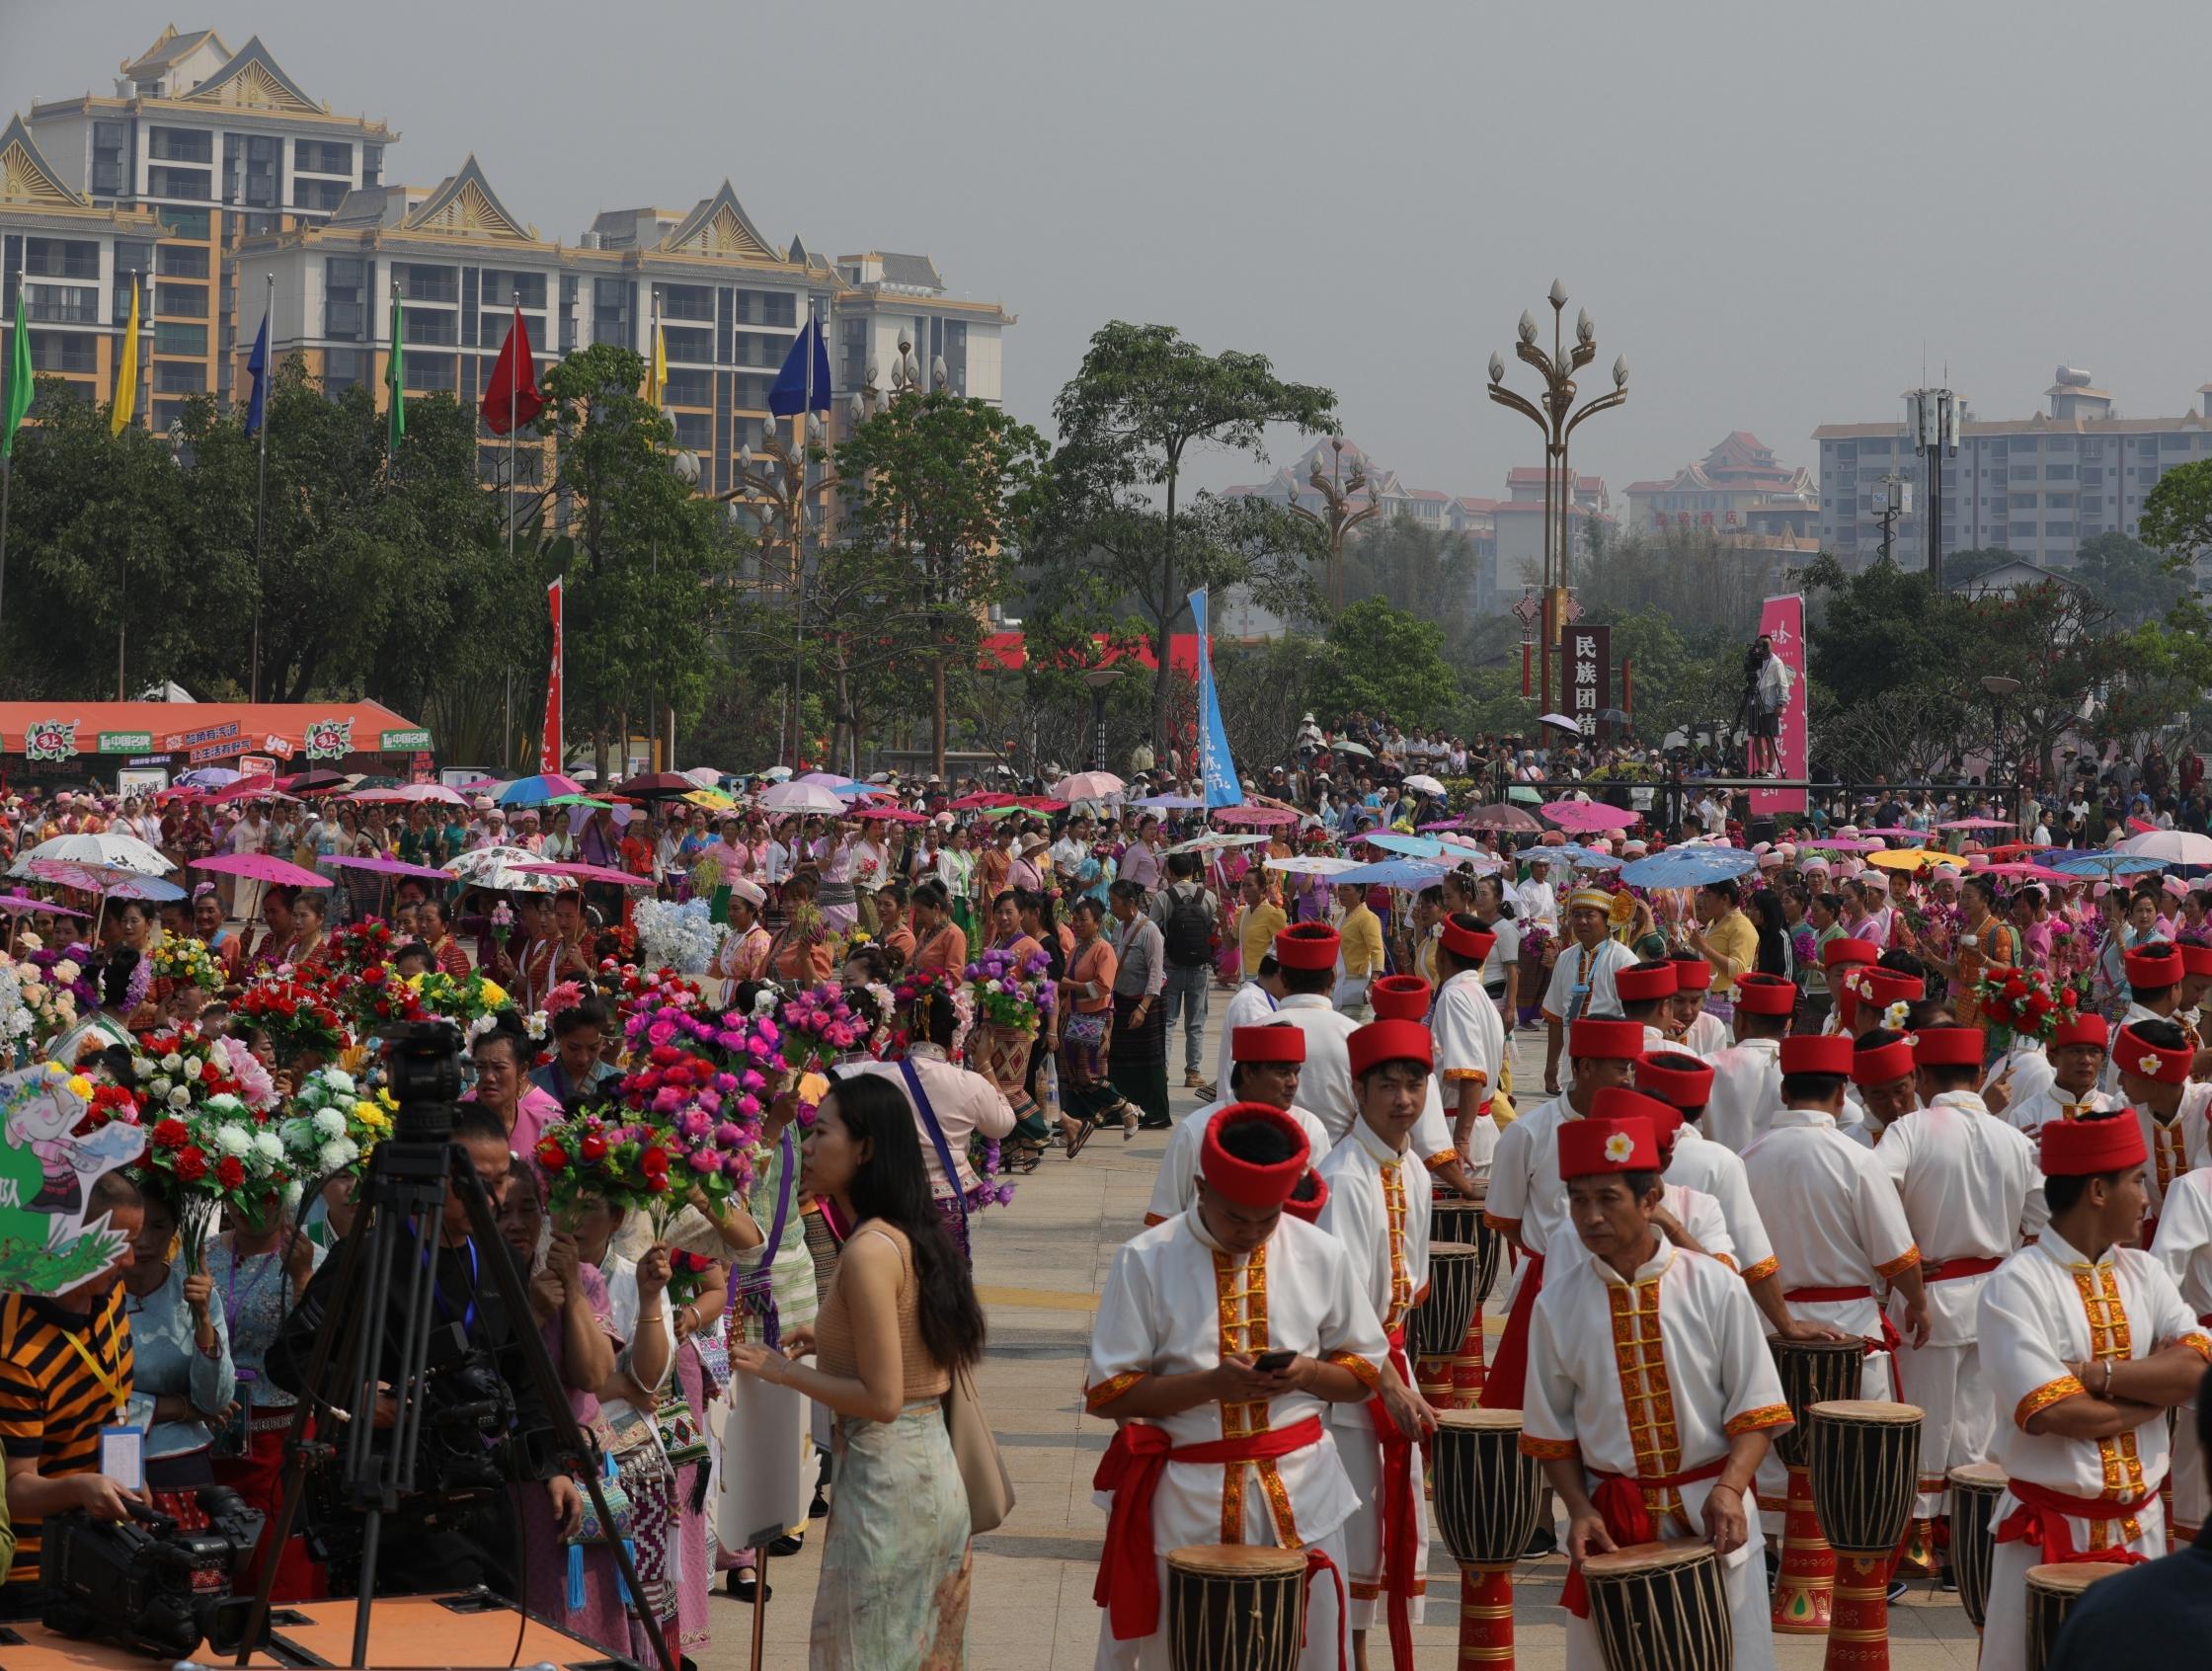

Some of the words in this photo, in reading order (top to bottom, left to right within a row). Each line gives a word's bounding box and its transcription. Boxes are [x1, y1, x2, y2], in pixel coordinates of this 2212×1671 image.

[1574, 634, 1597, 736] 民族团结
[111, 735, 150, 747] 中国名牌
[266, 734, 293, 756] ye!
[392, 732, 429, 744] 中国名牌
[192, 739, 252, 760] 让生活有野气
[0, 1177, 21, 1208] 队
